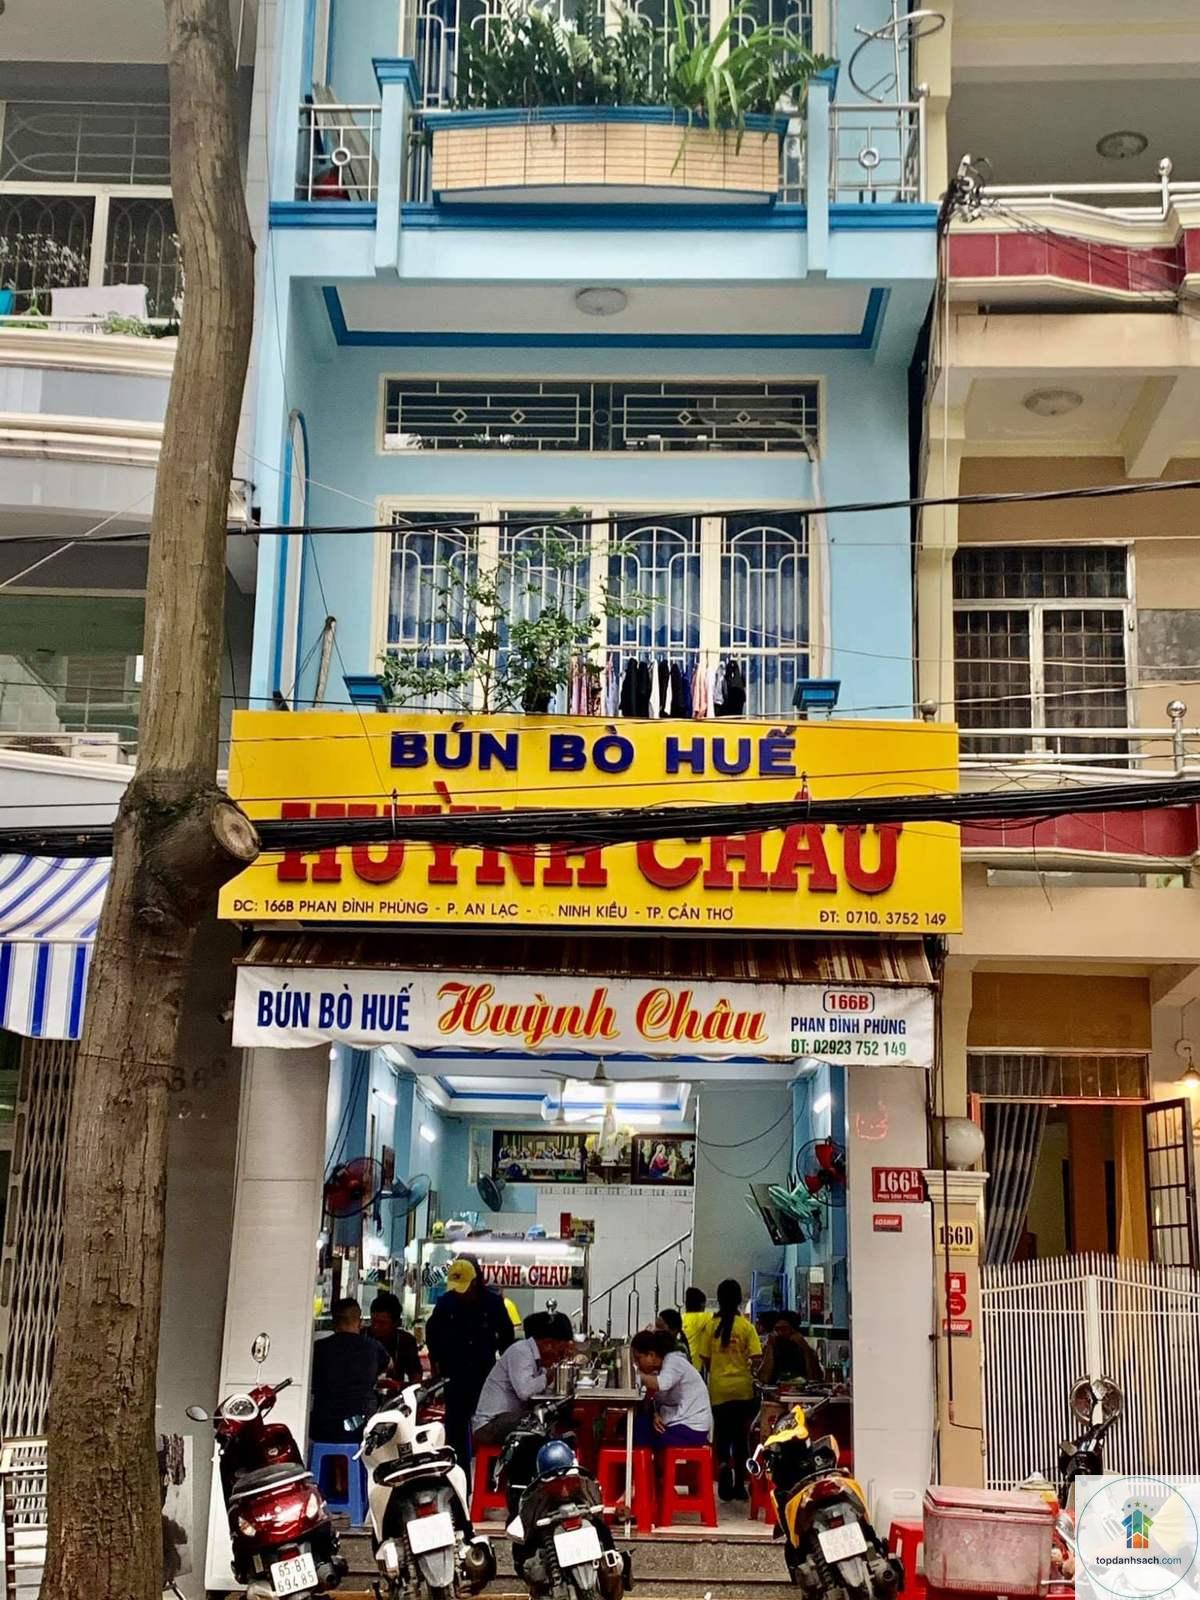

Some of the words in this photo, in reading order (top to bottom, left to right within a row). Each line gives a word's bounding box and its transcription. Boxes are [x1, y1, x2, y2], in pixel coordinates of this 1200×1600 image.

[391, 722, 519, 771] BÚN
[549, 725, 635, 773] BÒ
[665, 724, 798, 776] HUẾ
[233, 899, 258, 913] ĐC:
[264, 899, 294, 913] 166B
[299, 900, 337, 913] PHAN
[342, 897, 374, 914] ĐÌNH
[379, 897, 429, 915] PHÙNG
[447, 904, 459, 916] P.
[464, 904, 485, 916] AN
[491, 904, 519, 918] LẠC
[558, 904, 591, 918] NINH
[596, 900, 628, 919] KIỀU
[646, 906, 664, 920] TP.
[668, 902, 700, 920] CẦN
[706, 906, 734, 921] THƠ
[819, 910, 840, 923] ĐT:
[846, 911, 881, 925] 0710.
[885, 912, 919, 925] 3752
[925, 912, 946, 926] 149
[828, 994, 869, 1011] 166B
[257, 983, 311, 1028] BÚN
[318, 984, 353, 1029] BÒ
[361, 983, 414, 1031] HUẾ
[437, 982, 620, 1048] Huỳnh
[636, 986, 768, 1042] Châu
[791, 1016, 826, 1033] PHAN
[829, 1014, 861, 1035] ĐÌNH
[864, 1015, 907, 1036] PHÙNG
[791, 1038, 810, 1055] ĐT:
[813, 1039, 852, 1056] 02923
[856, 1041, 879, 1057] 752
[884, 1042, 907, 1057] 149
[879, 1171, 920, 1193] 166B
